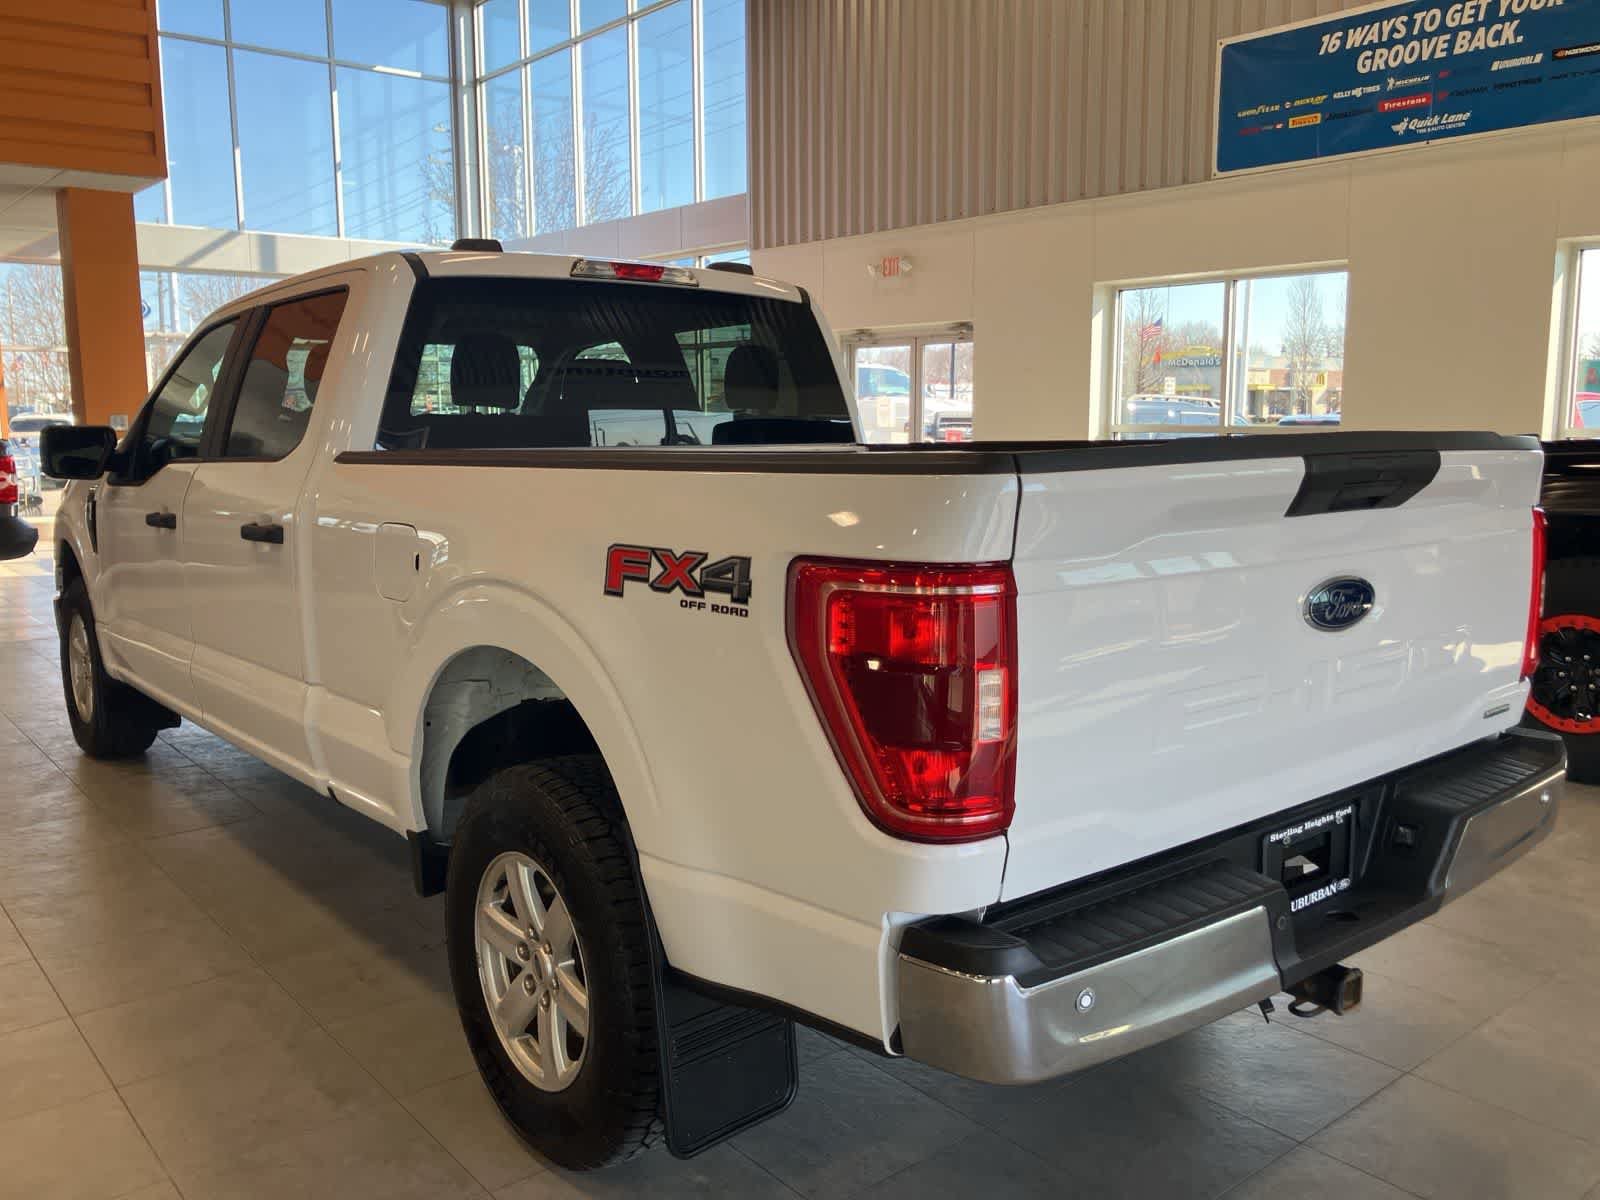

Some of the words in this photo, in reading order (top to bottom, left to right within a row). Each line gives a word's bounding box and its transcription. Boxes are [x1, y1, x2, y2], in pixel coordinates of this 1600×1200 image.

[1319, 32, 1343, 56] 16
[1346, 15, 1408, 49] WAYS
[1412, 9, 1442, 35] TO
[1446, 0, 1491, 28] GET
[1357, 35, 1450, 74] GROOVE
[1453, 19, 1524, 55] BACK.
[1408, 116, 1440, 130] Quick
[1441, 111, 1470, 124] Lane
[604, 543, 752, 605] FX4
[680, 599, 706, 611] OFF
[711, 604, 749, 617] ROAD
[1325, 588, 1364, 620] Ford
[1270, 825, 1303, 842] Sterling
[1305, 814, 1334, 830] Heights
[1336, 806, 1352, 819] Ford
[1291, 883, 1336, 912] UBURBAN
